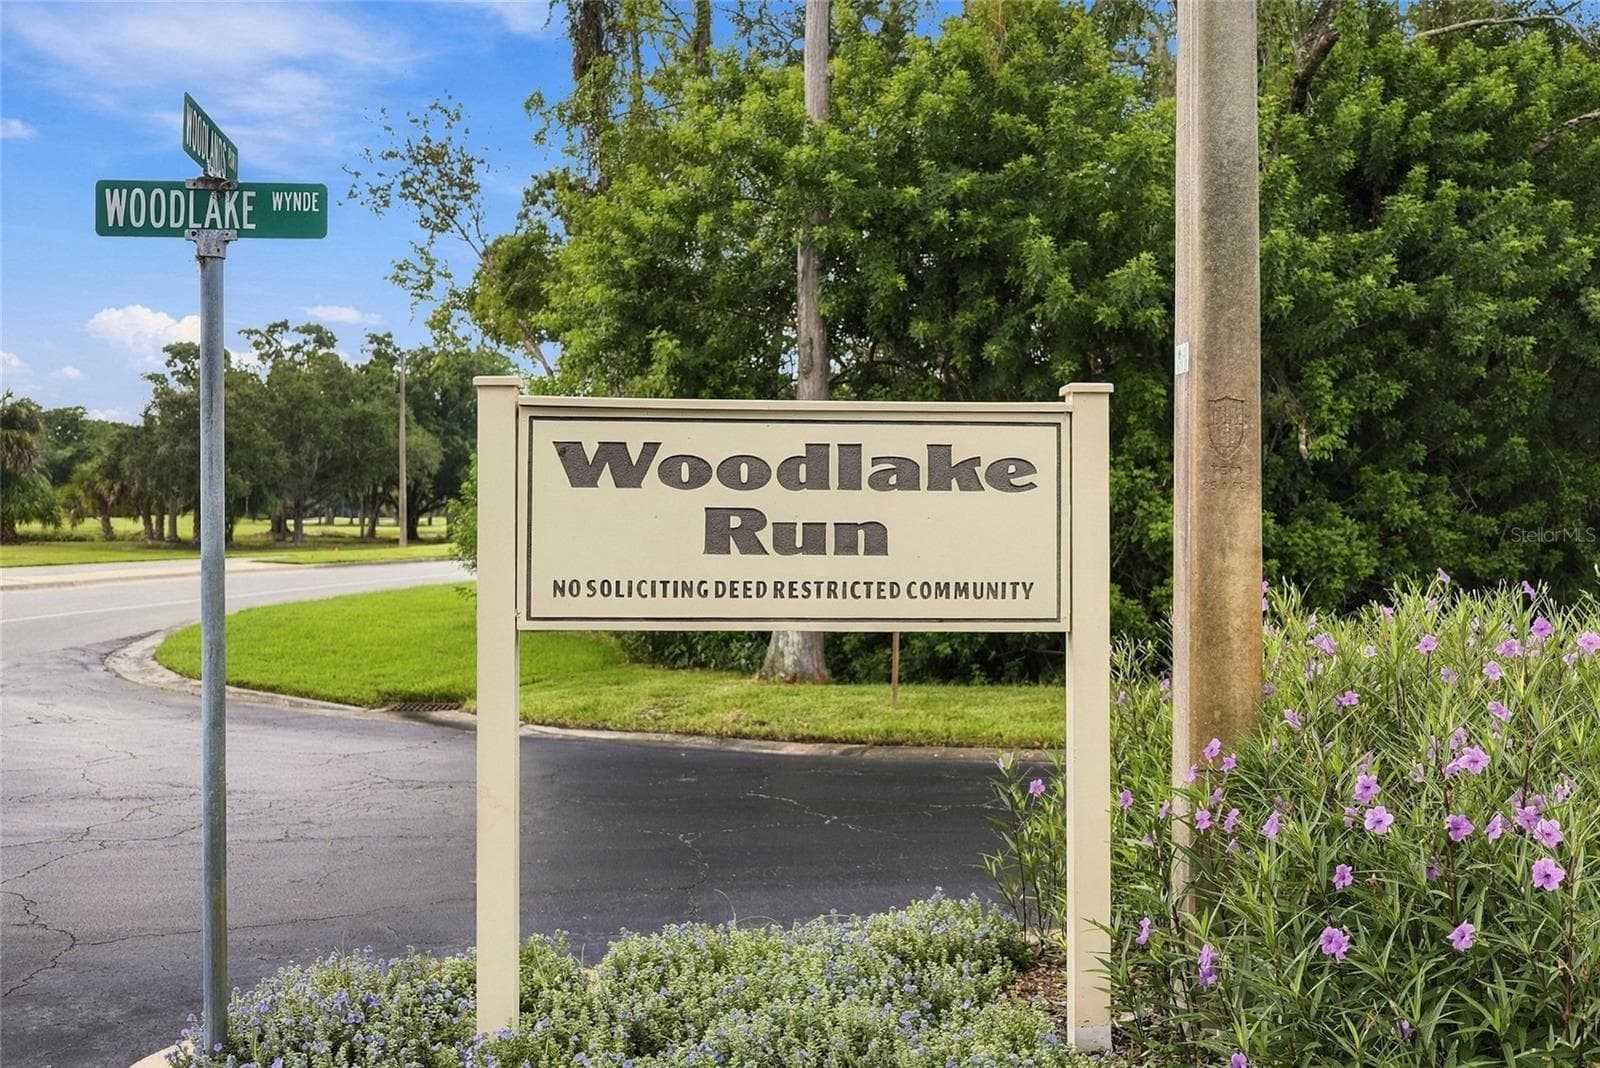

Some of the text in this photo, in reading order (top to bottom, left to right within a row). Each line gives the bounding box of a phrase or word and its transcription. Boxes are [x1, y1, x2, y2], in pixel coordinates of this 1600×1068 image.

[187, 103, 227, 178] WOODLANDS
[105, 188, 319, 229] WOODLAKE WYNDE
[552, 442, 1037, 492] Woodlake
[703, 507, 888, 555] Run
[553, 579, 1034, 600] NO SOLICITING DEED RESTRICTED COMMUNITY
